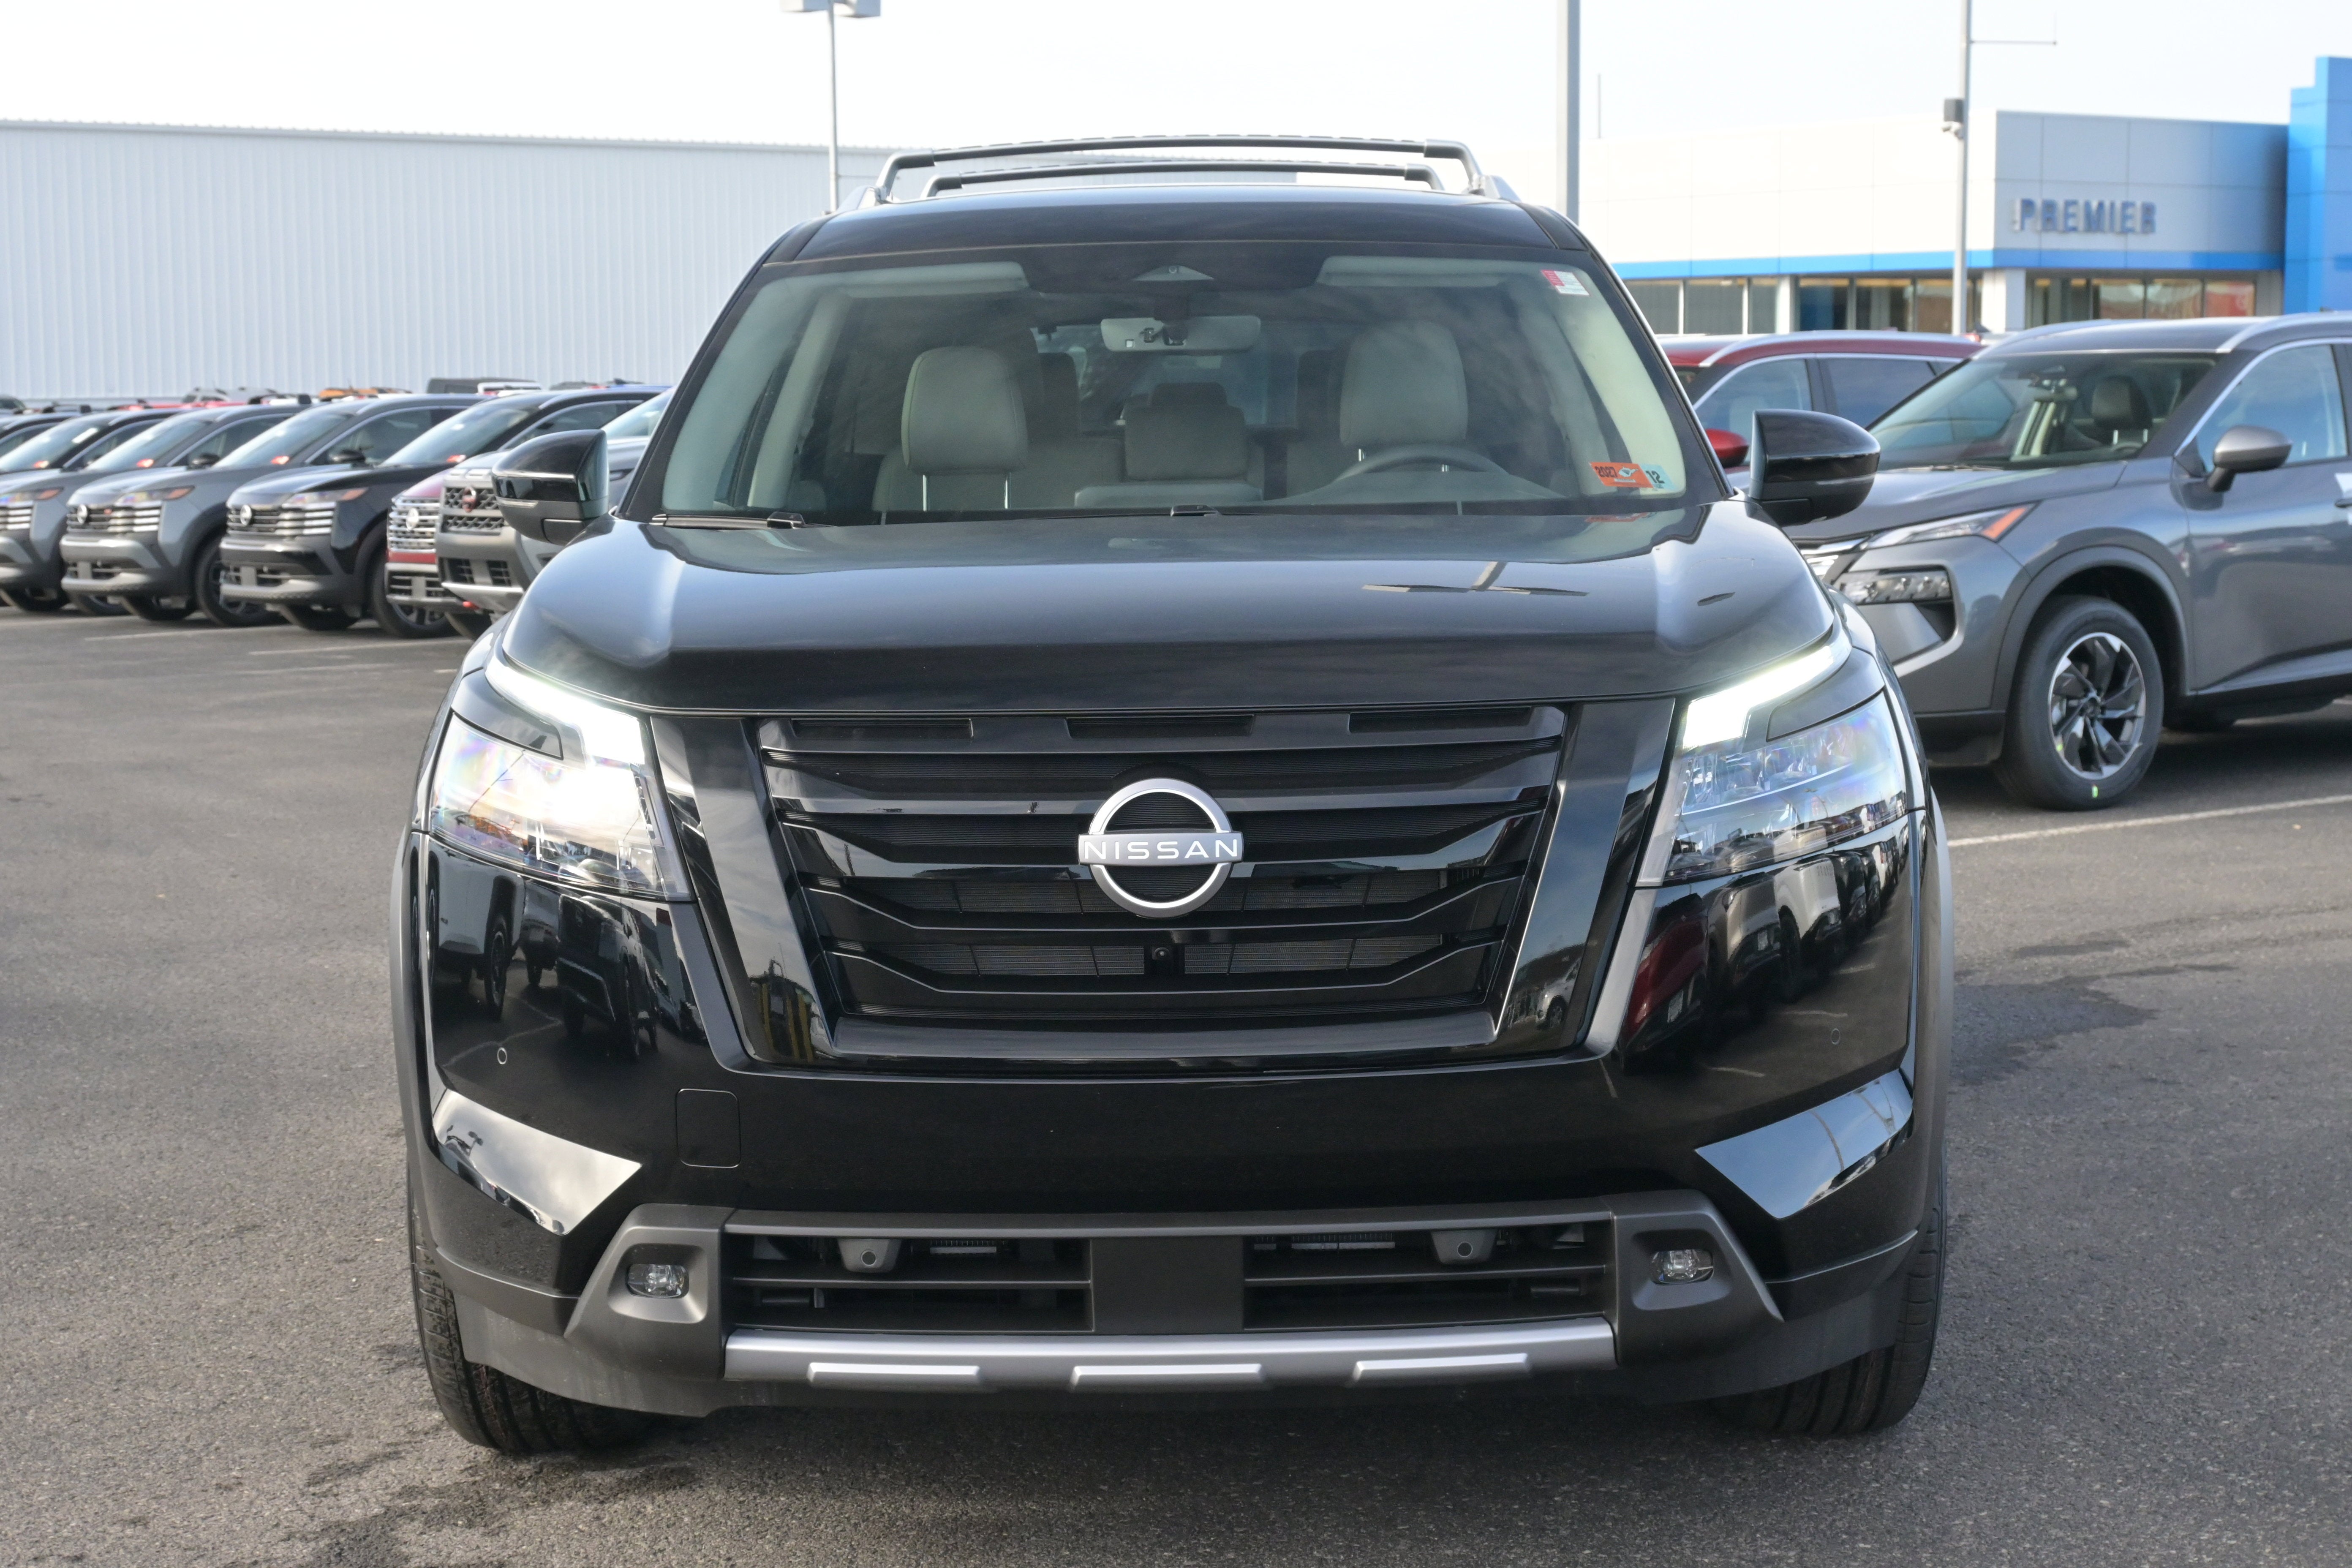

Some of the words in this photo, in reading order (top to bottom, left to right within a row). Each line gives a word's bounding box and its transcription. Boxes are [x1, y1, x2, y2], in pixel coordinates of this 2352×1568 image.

[2014, 198, 2156, 233] PREMIER
[1595, 466, 1618, 478] 2027
[1645, 471, 1665, 484] 12
[1084, 839, 1238, 860] NISSAN
